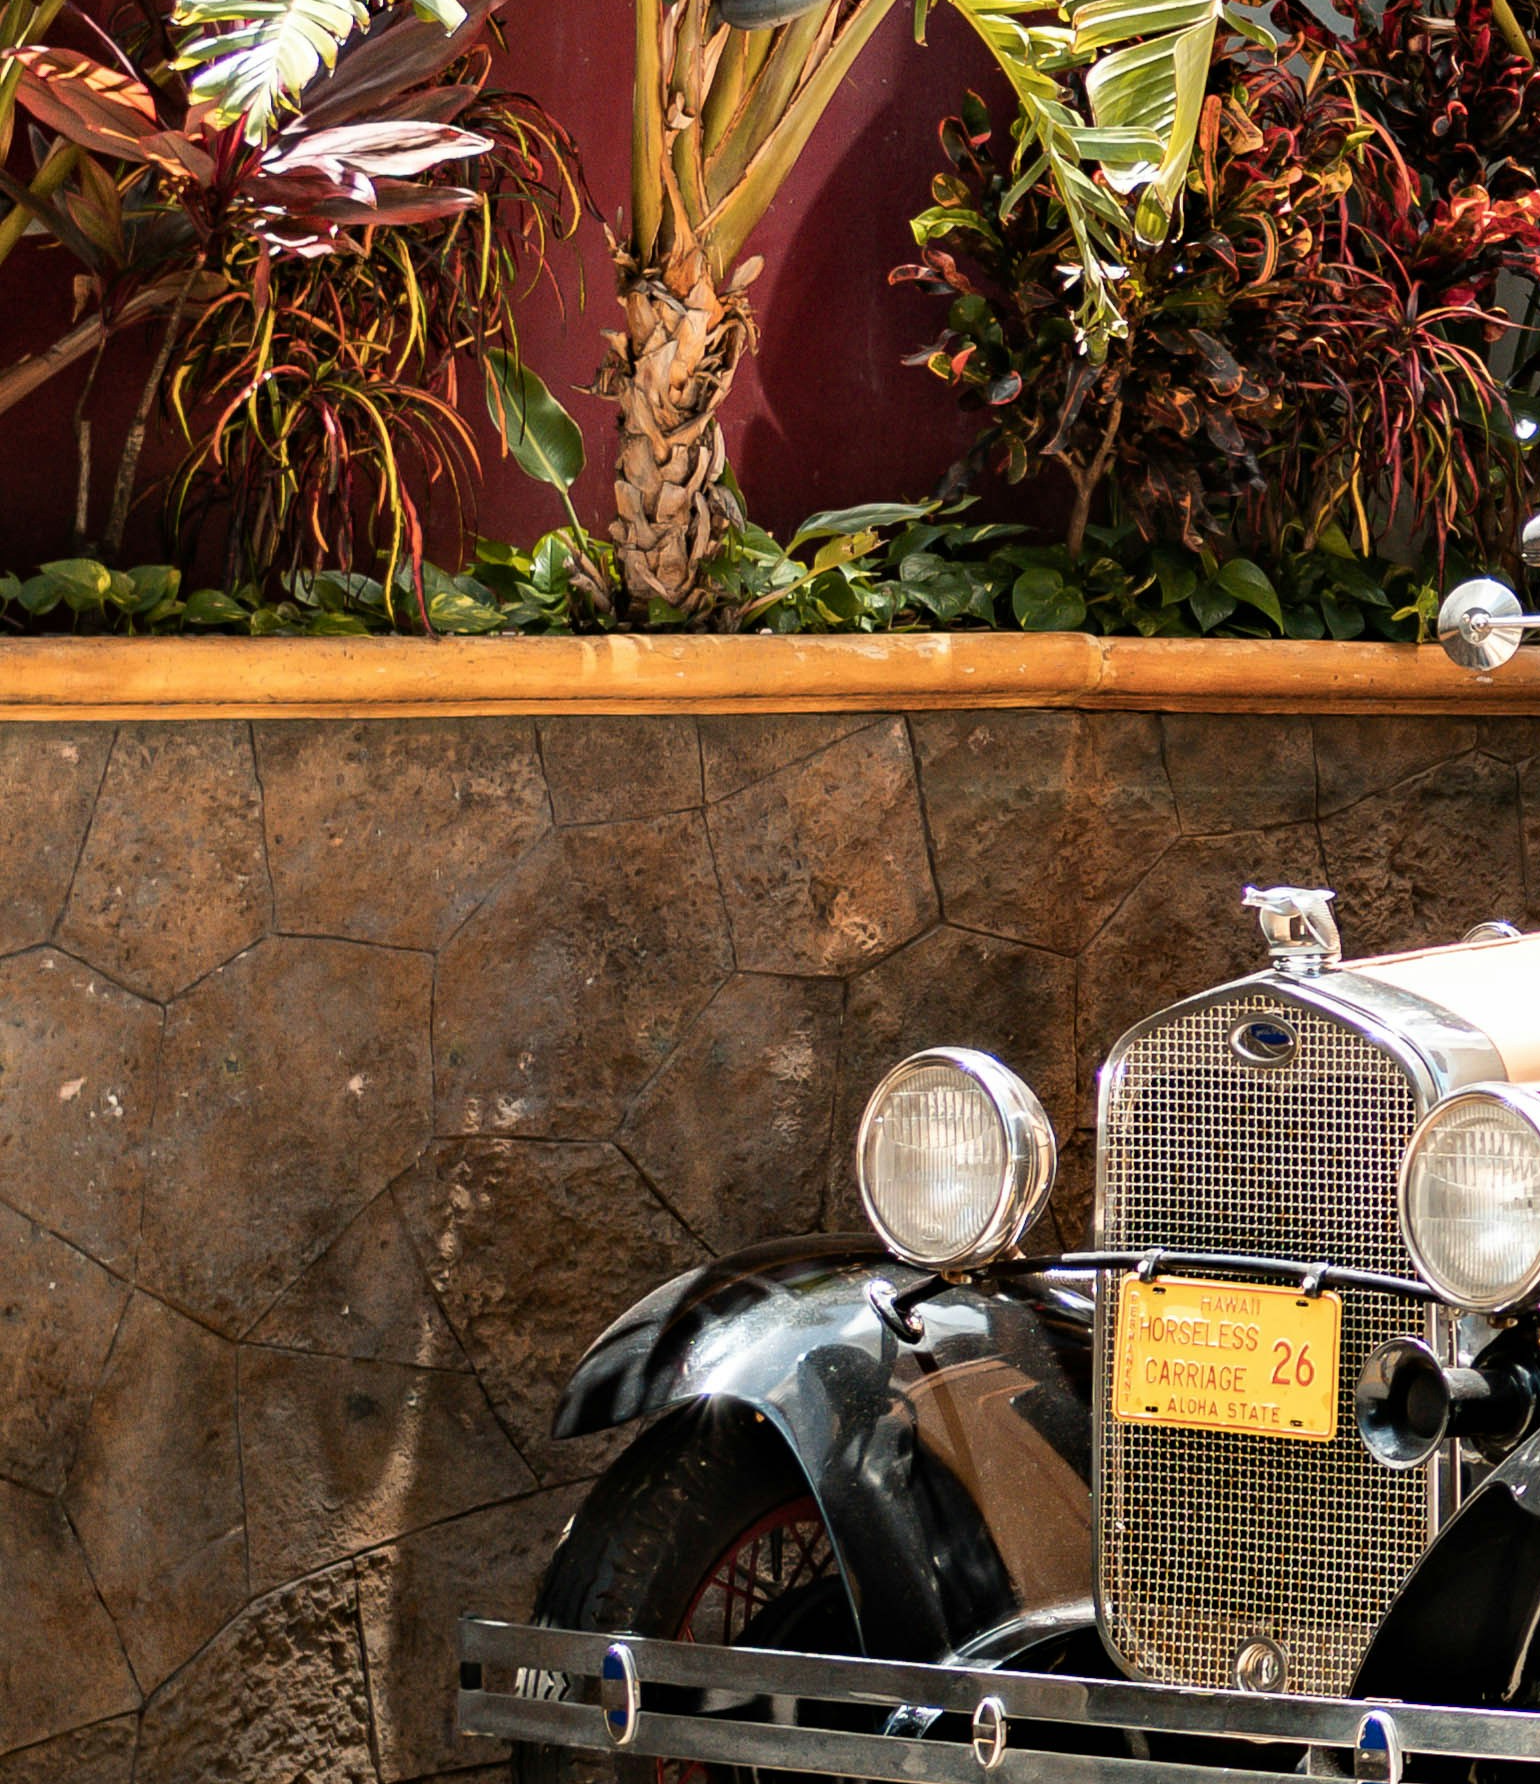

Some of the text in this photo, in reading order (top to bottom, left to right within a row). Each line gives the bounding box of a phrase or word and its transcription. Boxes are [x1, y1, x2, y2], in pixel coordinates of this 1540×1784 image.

[1200, 1295, 1261, 1315] HAWAII
[1124, 1291, 1138, 1402] PERMANENT
[1140, 1316, 1260, 1352] HORSELESS
[1145, 1357, 1247, 1393] CARRIAGE
[1271, 1338, 1315, 1387] 26
[1167, 1397, 1281, 1424] ALOHA STATE
